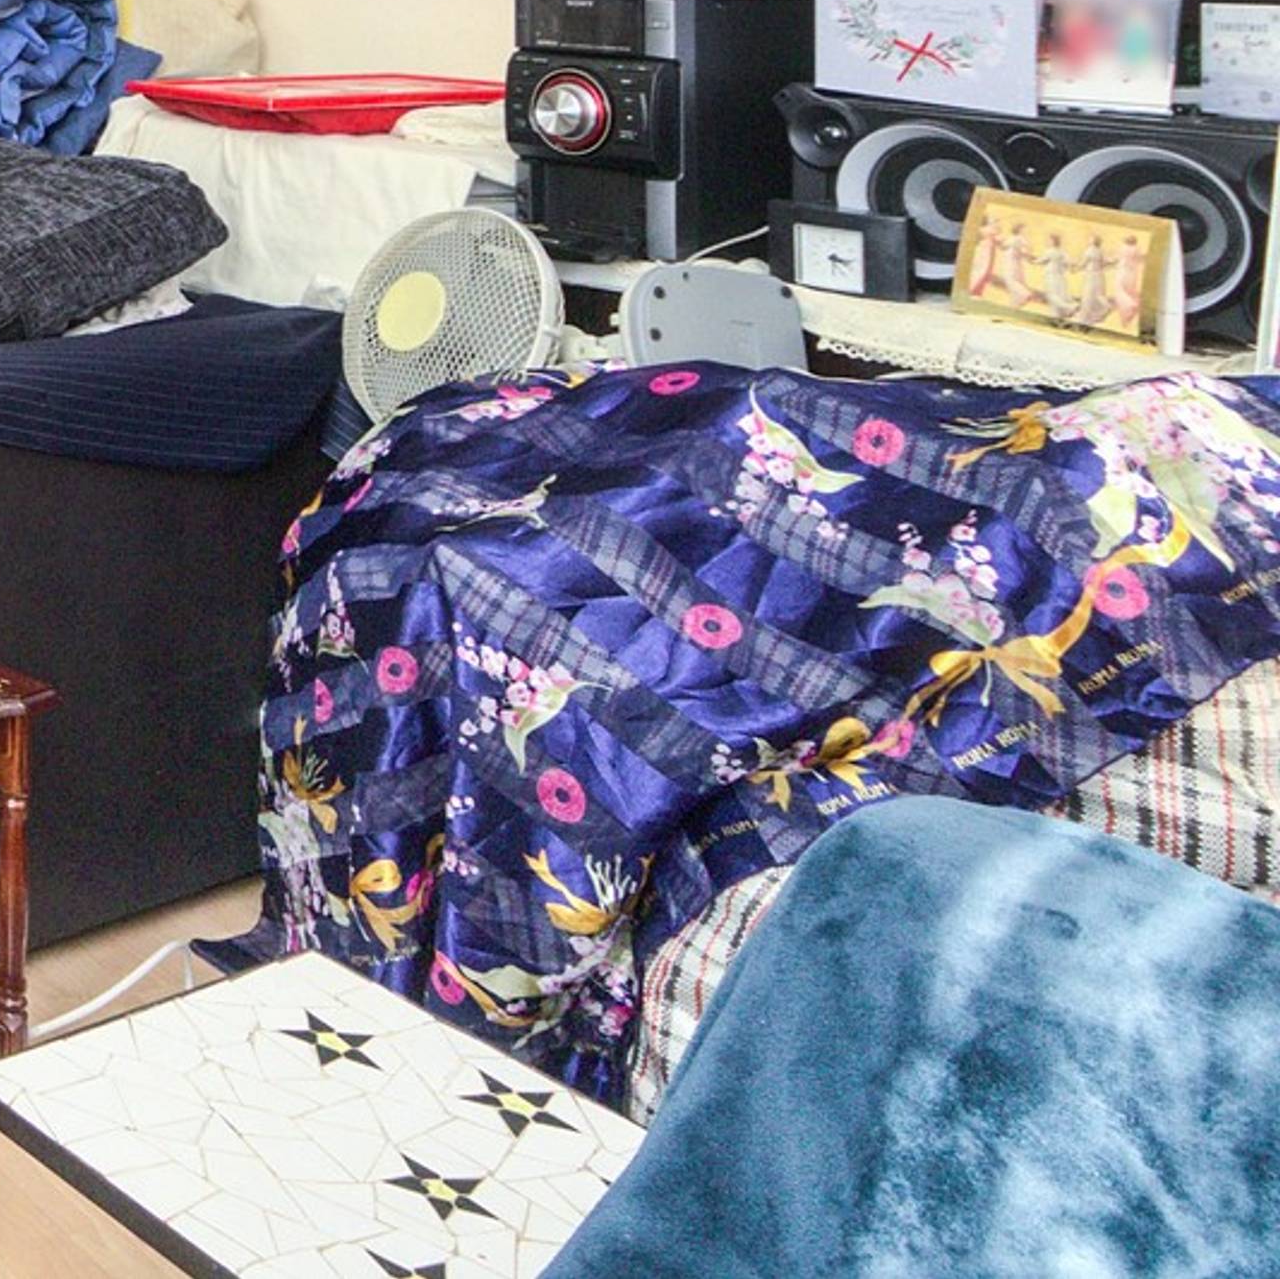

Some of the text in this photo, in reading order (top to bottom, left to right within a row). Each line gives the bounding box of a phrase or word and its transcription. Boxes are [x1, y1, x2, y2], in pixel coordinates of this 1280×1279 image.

[1077, 638, 1164, 696] ROMA ROMA
[950, 720, 1041, 771] ROMA ROMA
